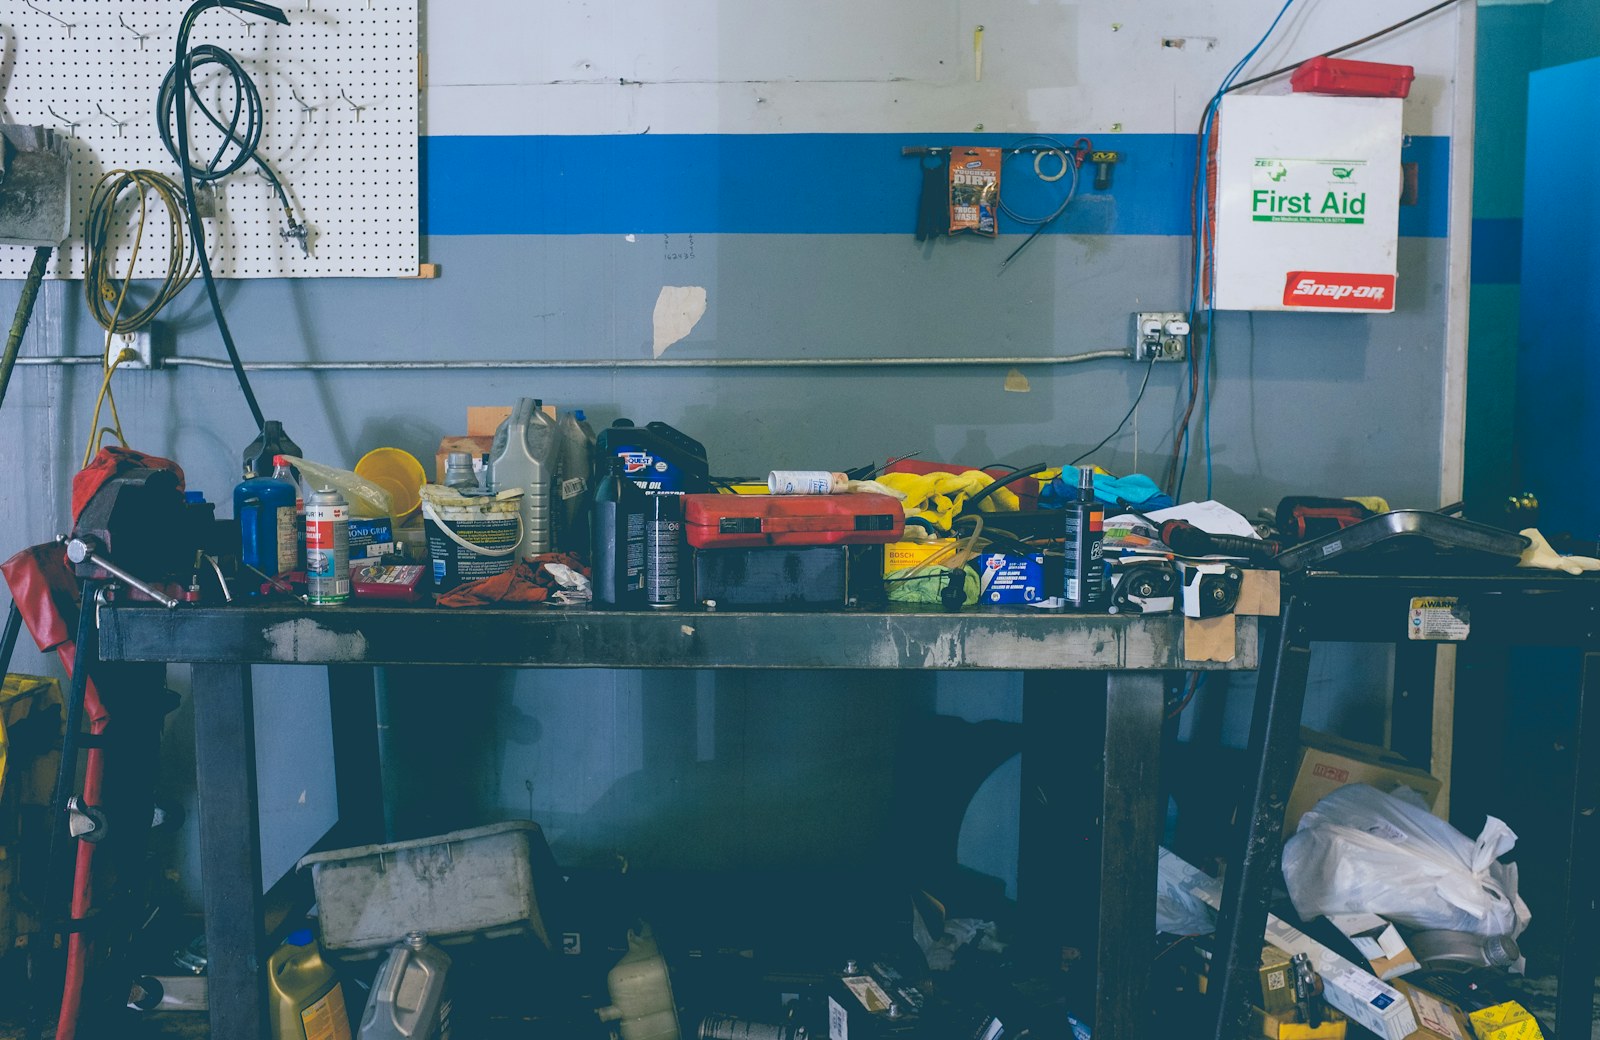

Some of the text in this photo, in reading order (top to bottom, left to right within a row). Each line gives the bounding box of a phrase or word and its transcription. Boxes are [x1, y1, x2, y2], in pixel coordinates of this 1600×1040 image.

[953, 174, 997, 186] DIRT
[1252, 189, 1366, 216] First Aid
[953, 206, 977, 214] TRUCK
[954, 213, 978, 221] WASH
[1293, 279, 1385, 301] Snap-on
[648, 481, 662, 490] OIL
[370, 526, 388, 535] GRIP
